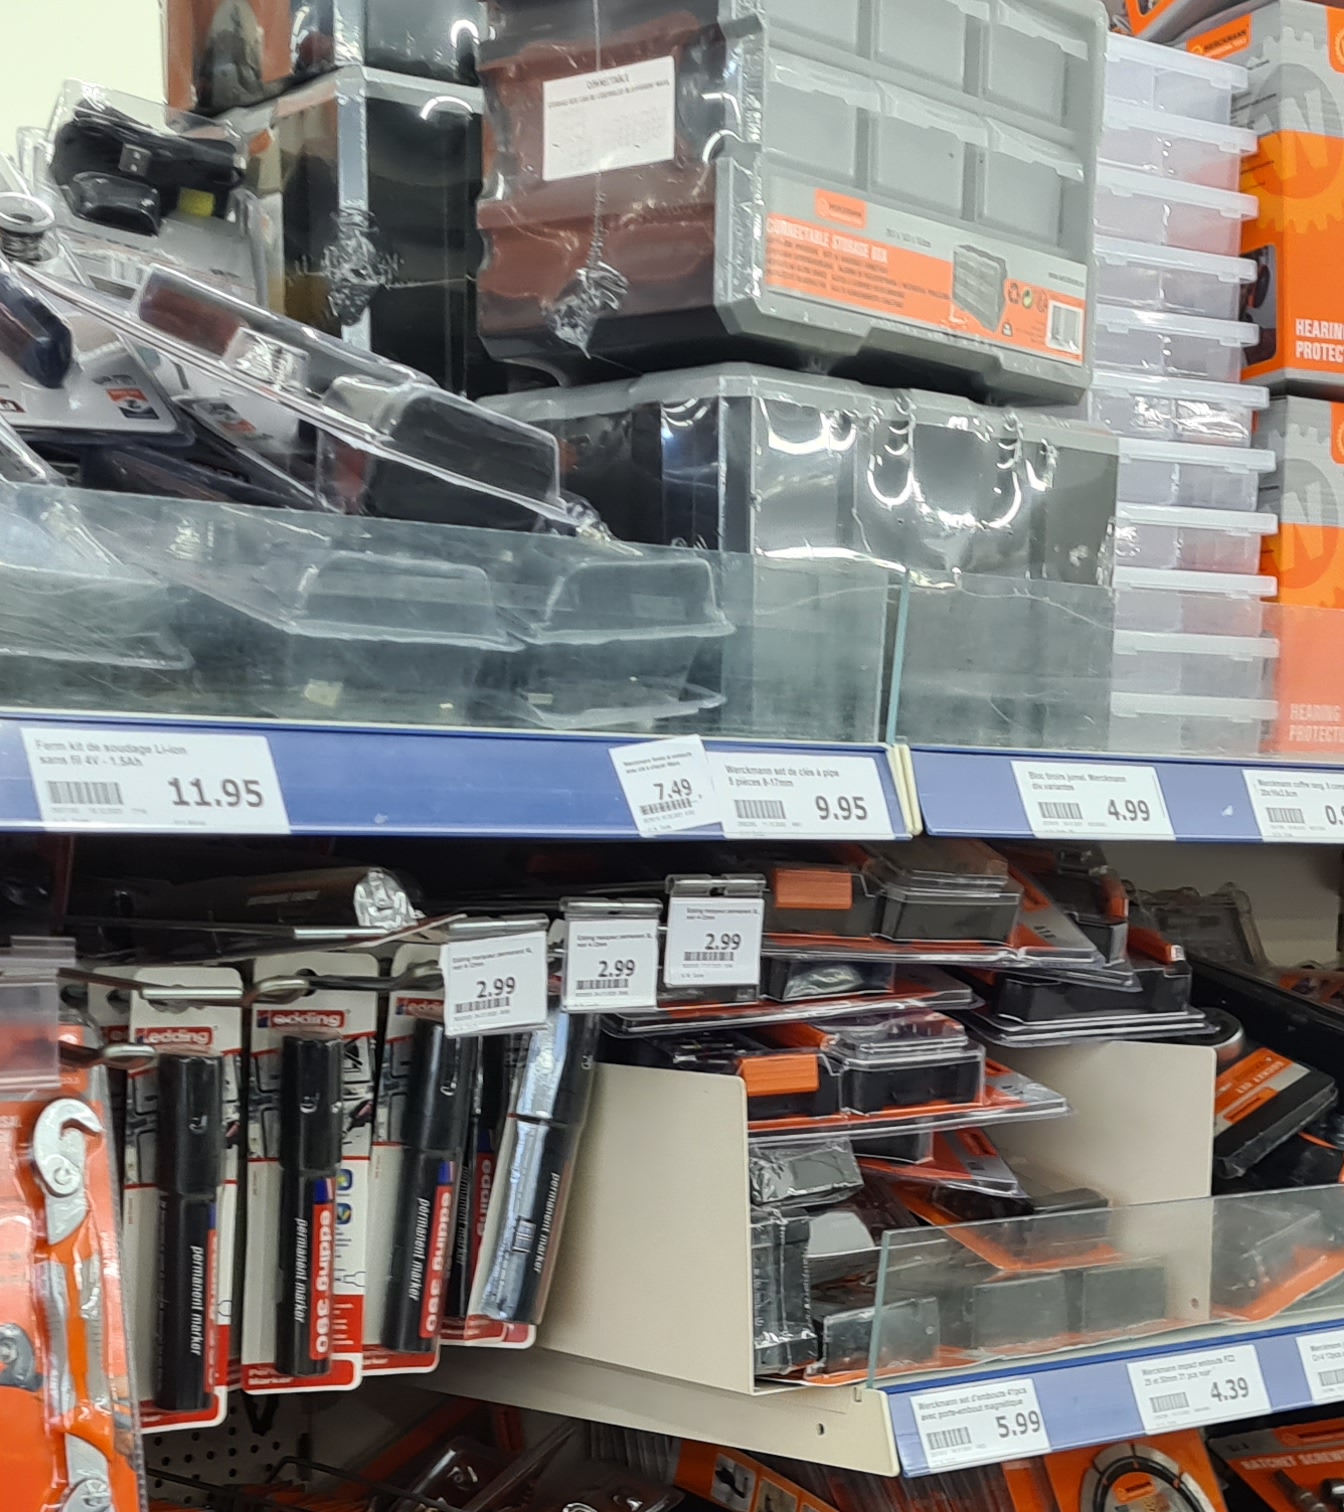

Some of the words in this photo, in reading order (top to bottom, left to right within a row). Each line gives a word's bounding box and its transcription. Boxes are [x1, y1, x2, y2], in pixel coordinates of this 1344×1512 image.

[1289, 704, 1341, 723] HEARING
[167, 777, 265, 808] 11.95
[652, 777, 693, 801] 7.49
[814, 795, 868, 821] 9.95
[1107, 799, 1151, 822] 4.99
[705, 933, 741, 950] 2.99
[597, 959, 636, 978] 2.99
[476, 976, 516, 999] 2.99
[274, 1012, 342, 1028] edding
[149, 1030, 210, 1046] edding
[413, 1195, 431, 1256] permanent
[295, 1216, 309, 1277] permanent
[315, 1209, 332, 1292] edding
[531, 1232, 548, 1275] marker
[190, 1244, 205, 1306] permanent
[407, 1257, 423, 1302] marker
[294, 1279, 307, 1324] marker
[190, 1308, 205, 1357] marker
[1210, 1378, 1250, 1402] 4.39
[995, 1410, 1041, 1439] 5.99
[1242, 1452, 1293, 1471] RATCHET
